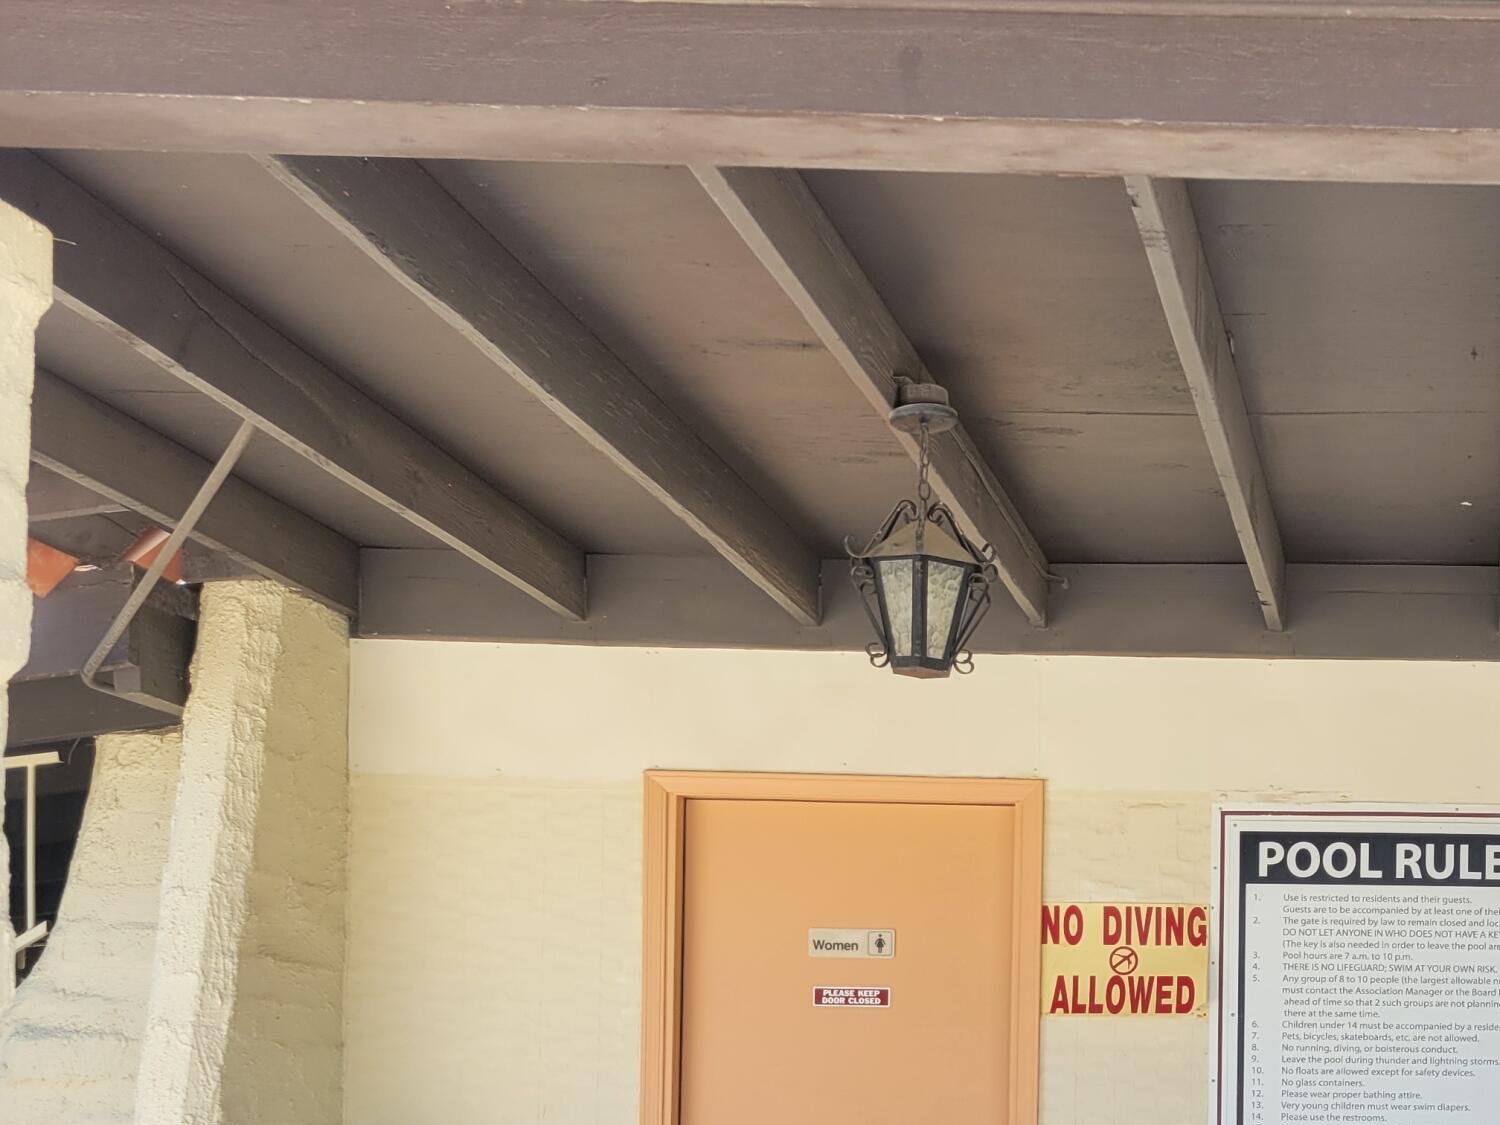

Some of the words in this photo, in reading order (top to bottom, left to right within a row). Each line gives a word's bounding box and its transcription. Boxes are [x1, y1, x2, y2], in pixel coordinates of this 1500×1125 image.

[1258, 841, 1382, 879] POOL
[1253, 892, 1261, 901] 1.
[1284, 892, 1299, 901] Use
[1300, 892, 1307, 902] is
[1309, 892, 1349, 902] restricted
[1350, 893, 1360, 902] to
[1361, 893, 1400, 902] residents
[1402, 893, 1419, 903] and
[1420, 894, 1440, 903] their
[1442, 894, 1472, 906] guests.
[1041, 904, 1084, 946] NO
[1103, 906, 1207, 947] DIVING
[1283, 928, 1296, 937] DO
[1298, 928, 1317, 937] NOT
[1318, 928, 1334, 937] LET
[1335, 928, 1372, 937] ANYONE
[1374, 928, 1383, 937] IN
[1384, 928, 1406, 938] WHO
[1408, 929, 1432, 938] DOES
[1434, 929, 1453, 938] NOT
[1455, 929, 1478, 938] HAVE
[1479, 929, 1486, 938] A
[813, 939, 859, 951] Women
[1253, 950, 1260, 960] 3.
[1283, 950, 1301, 960] Pool
[1303, 951, 1327, 960] hours
[1344, 951, 1349, 960] 7
[1371, 951, 1380, 960] to
[1382, 951, 1393, 960] 10
[1394, 954, 1413, 963] p.m.
[823, 989, 855, 997] PLEASE
[857, 989, 880, 997] KEEP
[1050, 975, 1195, 1014] ALLOWED
[848, 997, 881, 1005] CLOSED
[1252, 1042, 1258, 1052] 8.
[1282, 1042, 1294, 1052] No
[1296, 1043, 1331, 1054] running,
[1333, 1043, 1361, 1055] diving,
[1374, 1043, 1419, 1053] boisterous
[1421, 1044, 1458, 1053] conduct.
[1252, 1076, 1264, 1086] 11.
[1282, 1076, 1293, 1086] No
[1295, 1077, 1316, 1089] glass
[1318, 1077, 1364, 1087] containers.
[1252, 1111, 1264, 1120] 14.
[1282, 1111, 1308, 1121] Please
[1326, 1112, 1340, 1121] the
[1341, 1112, 1386, 1121] restrooms.
